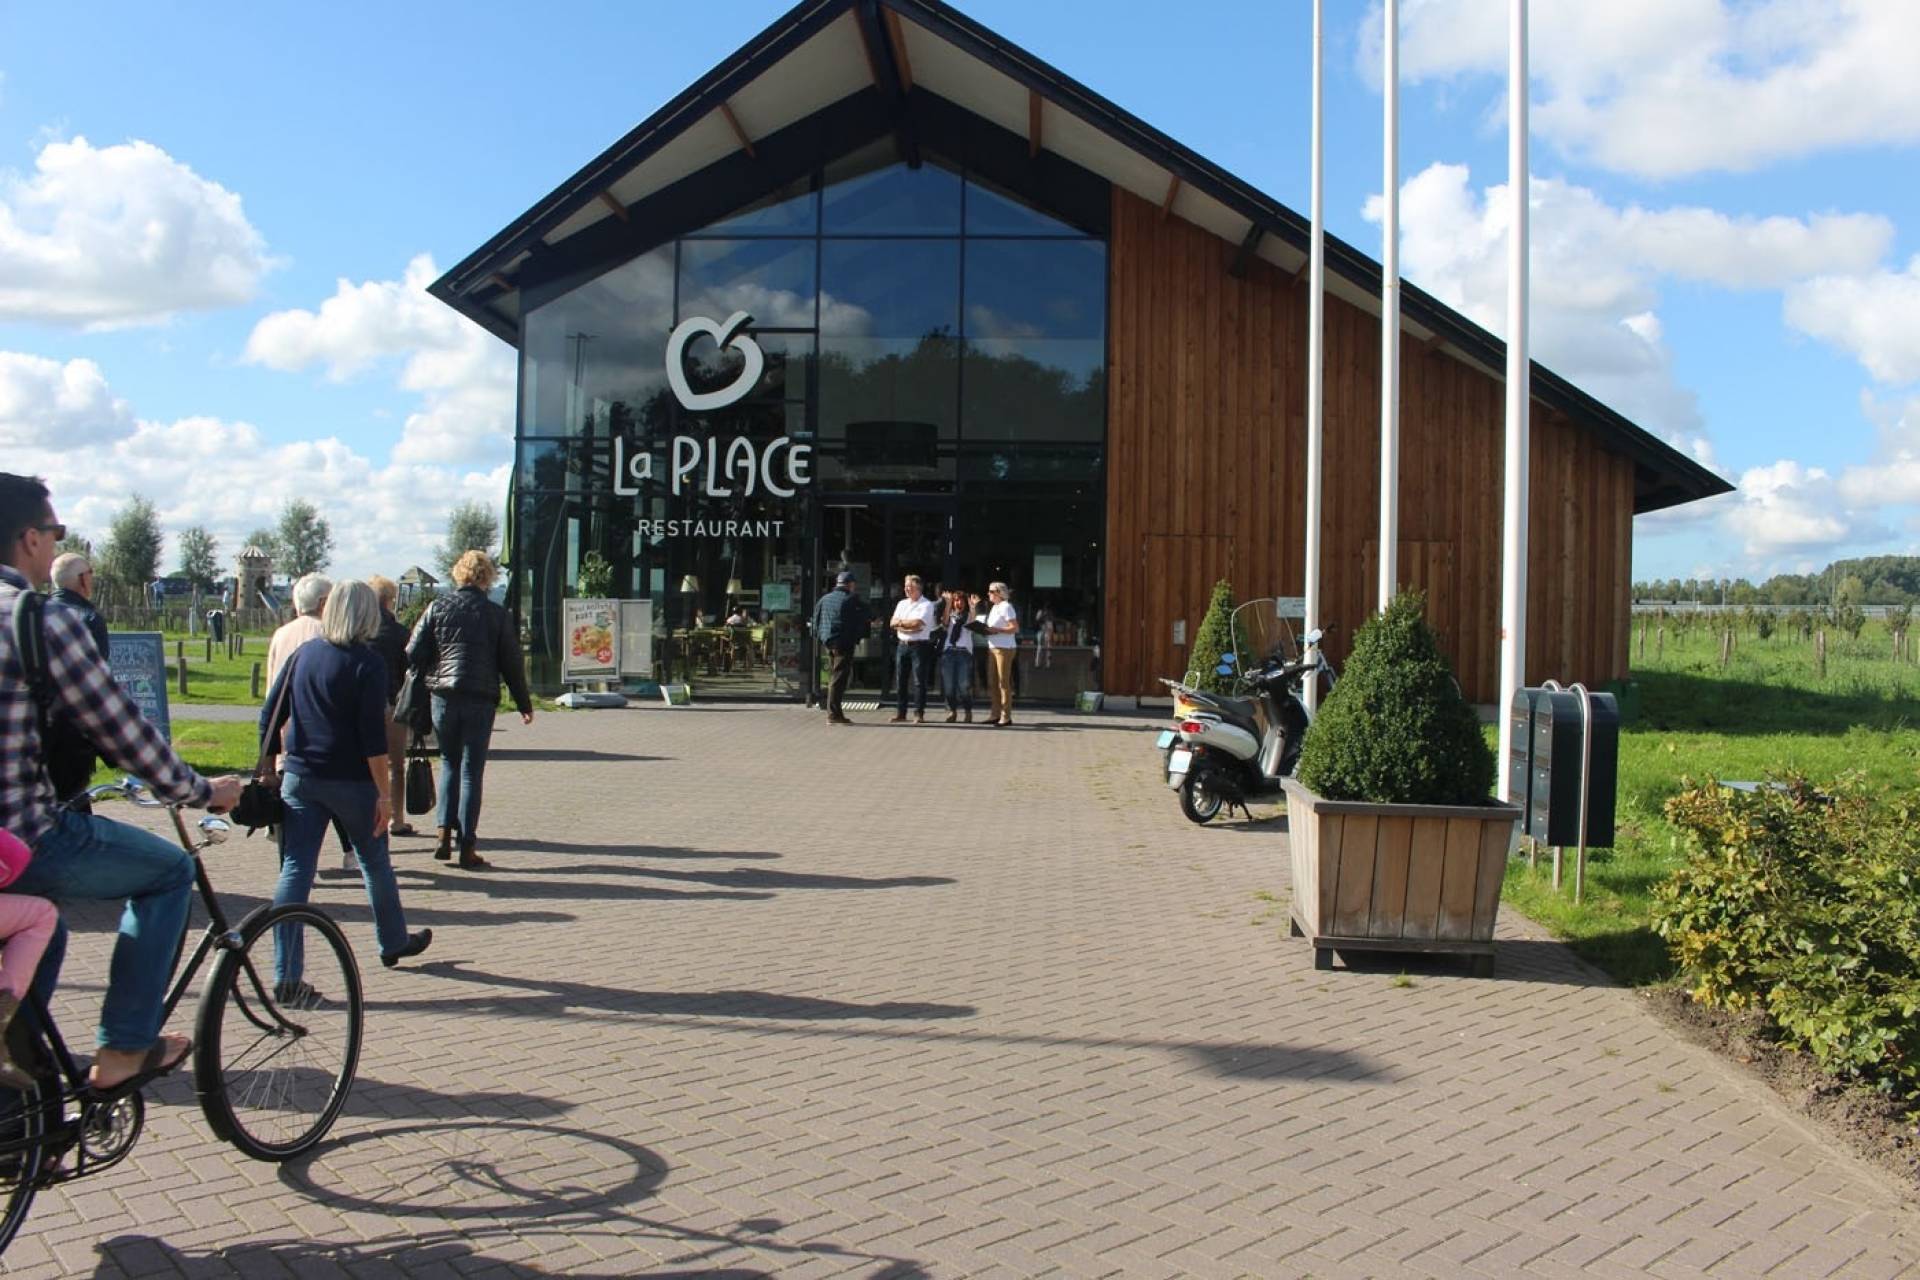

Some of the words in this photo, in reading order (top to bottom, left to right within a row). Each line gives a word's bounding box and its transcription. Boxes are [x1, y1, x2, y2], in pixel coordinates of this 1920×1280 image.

[614, 436, 652, 496] La
[672, 436, 812, 497] PLACE
[638, 519, 784, 538] RESTAURANT
